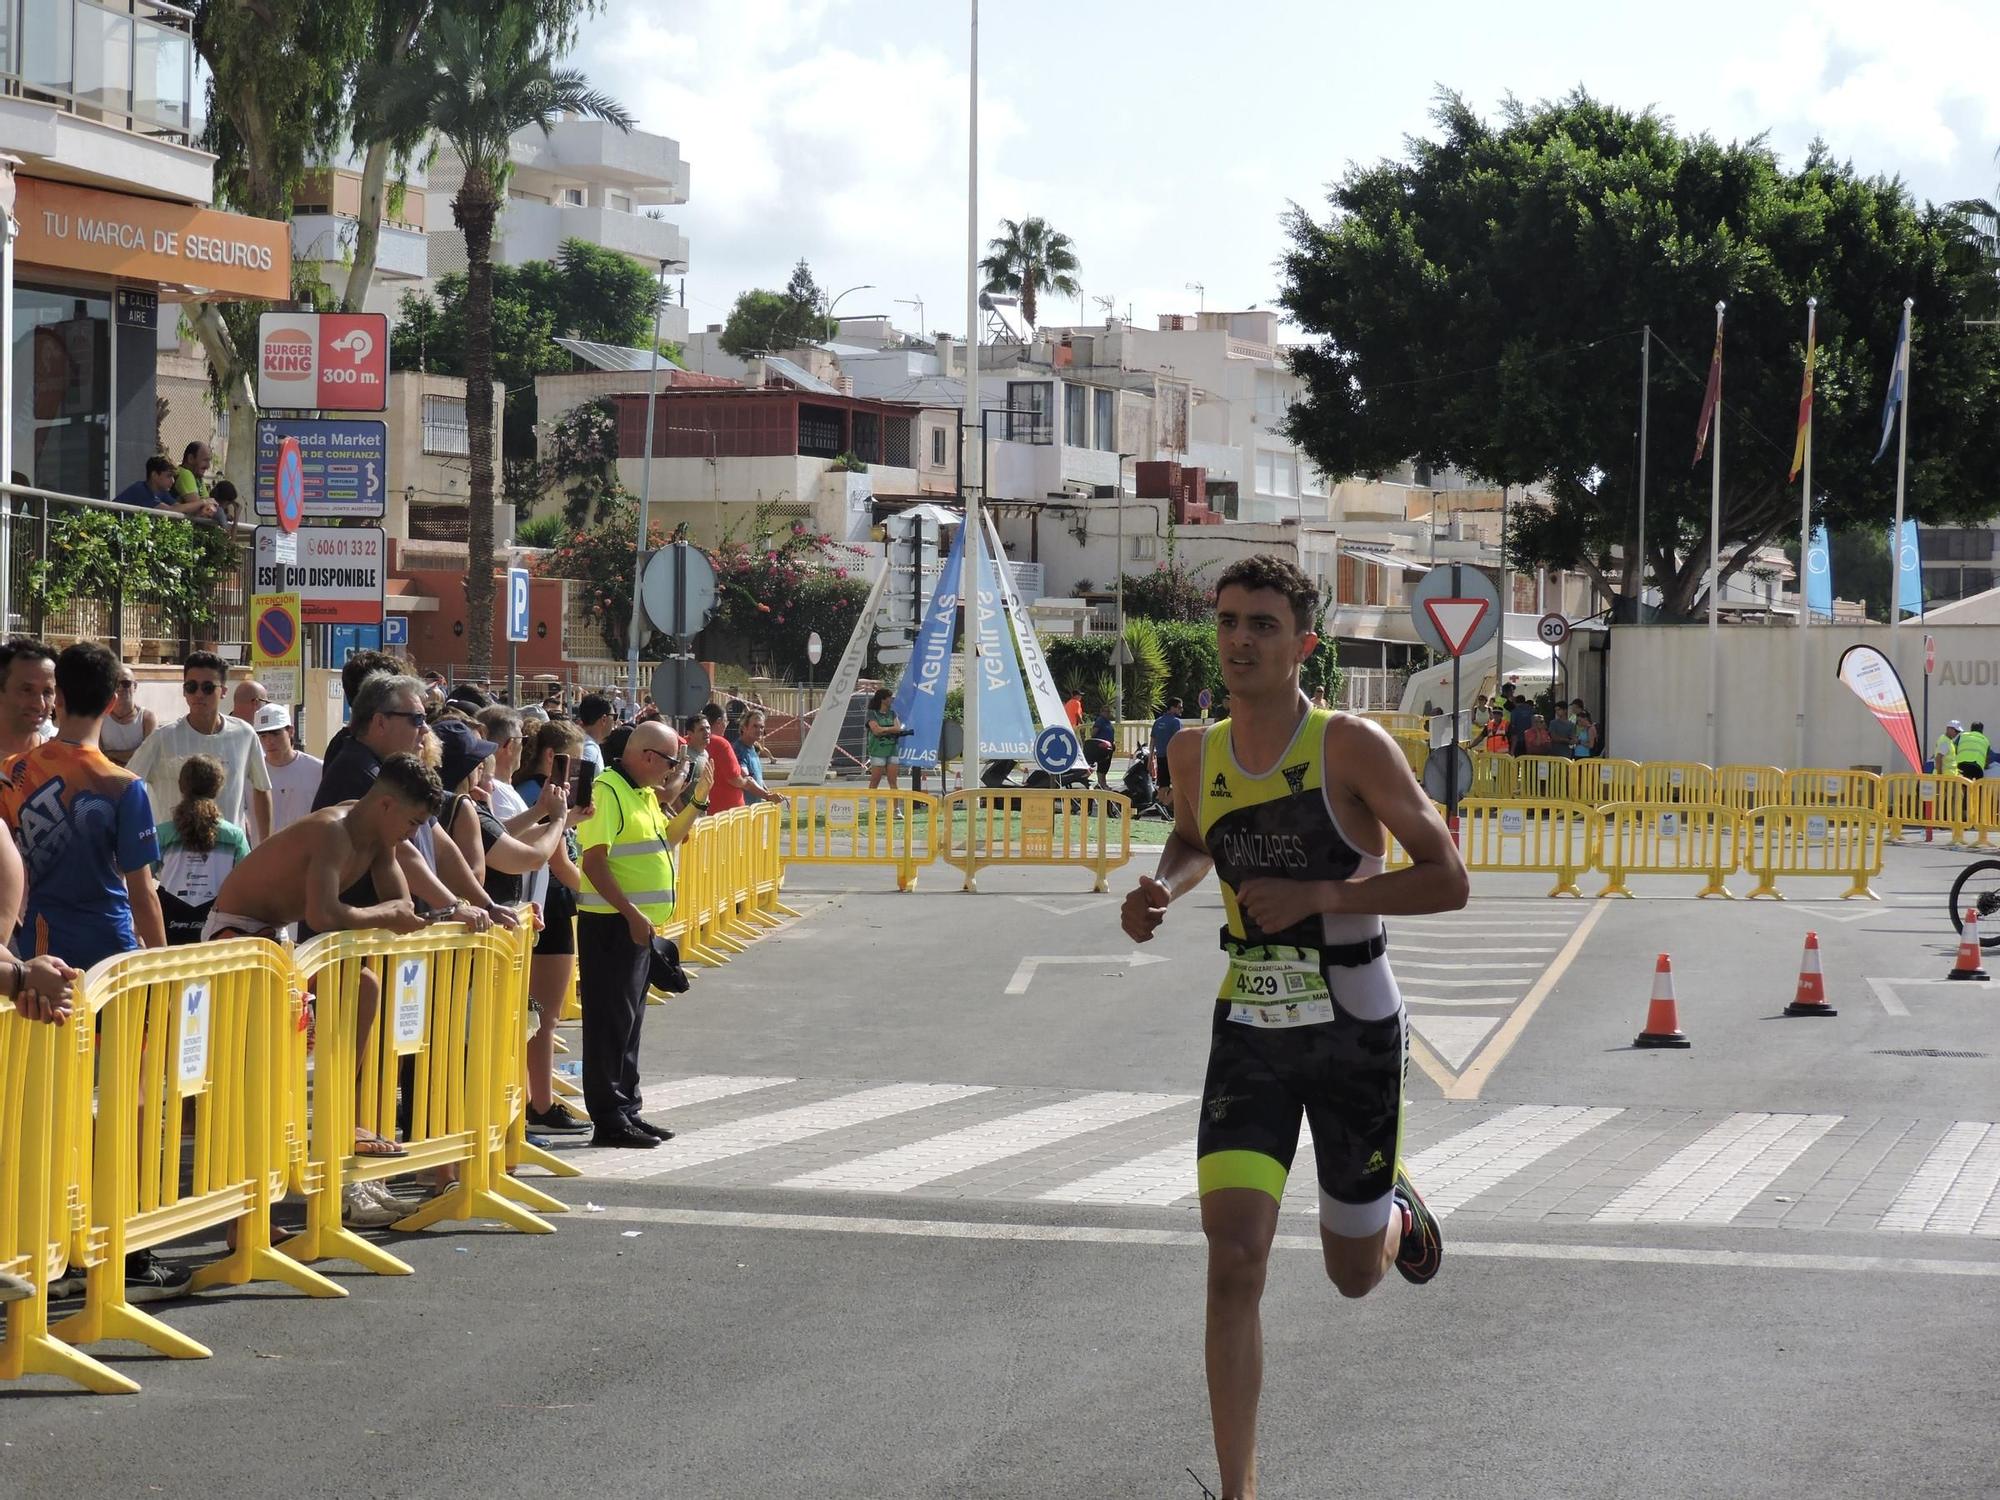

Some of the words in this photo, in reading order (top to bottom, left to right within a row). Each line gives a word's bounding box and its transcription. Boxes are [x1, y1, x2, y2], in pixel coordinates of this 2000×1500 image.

[43, 211, 68, 238] TU
[77, 217, 146, 250] MARCA
[154, 230, 178, 256] DE
[186, 234, 272, 271] SEGUROS
[130, 294, 156, 309] CALLE
[129, 310, 147, 323] AIRE
[265, 344, 312, 356] BURGER
[264, 355, 312, 371] KING
[323, 369, 357, 383] 300
[360, 372, 380, 384] m.
[331, 434, 381, 446] Market
[261, 450, 274, 458] TU
[311, 451, 323, 459] DE
[326, 451, 381, 459] CONFIANZA
[317, 541, 335, 556] 606
[338, 541, 348, 556] 01
[351, 541, 362, 556] 33
[365, 541, 376, 556] 22
[259, 567, 306, 586] ESPCIO
[309, 568, 375, 587] DISPONIBLE
[256, 596, 295, 606] ATENCIÓN
[515, 577, 527, 633] P
[386, 620, 400, 641] P
[1544, 624, 1563, 636] 30
[914, 594, 957, 696] ÁGUILAS
[1008, 593, 1050, 697] ÁGUILAS
[899, 749, 936, 762] UILAS
[1223, 827, 1308, 868] CAÑIZARES
